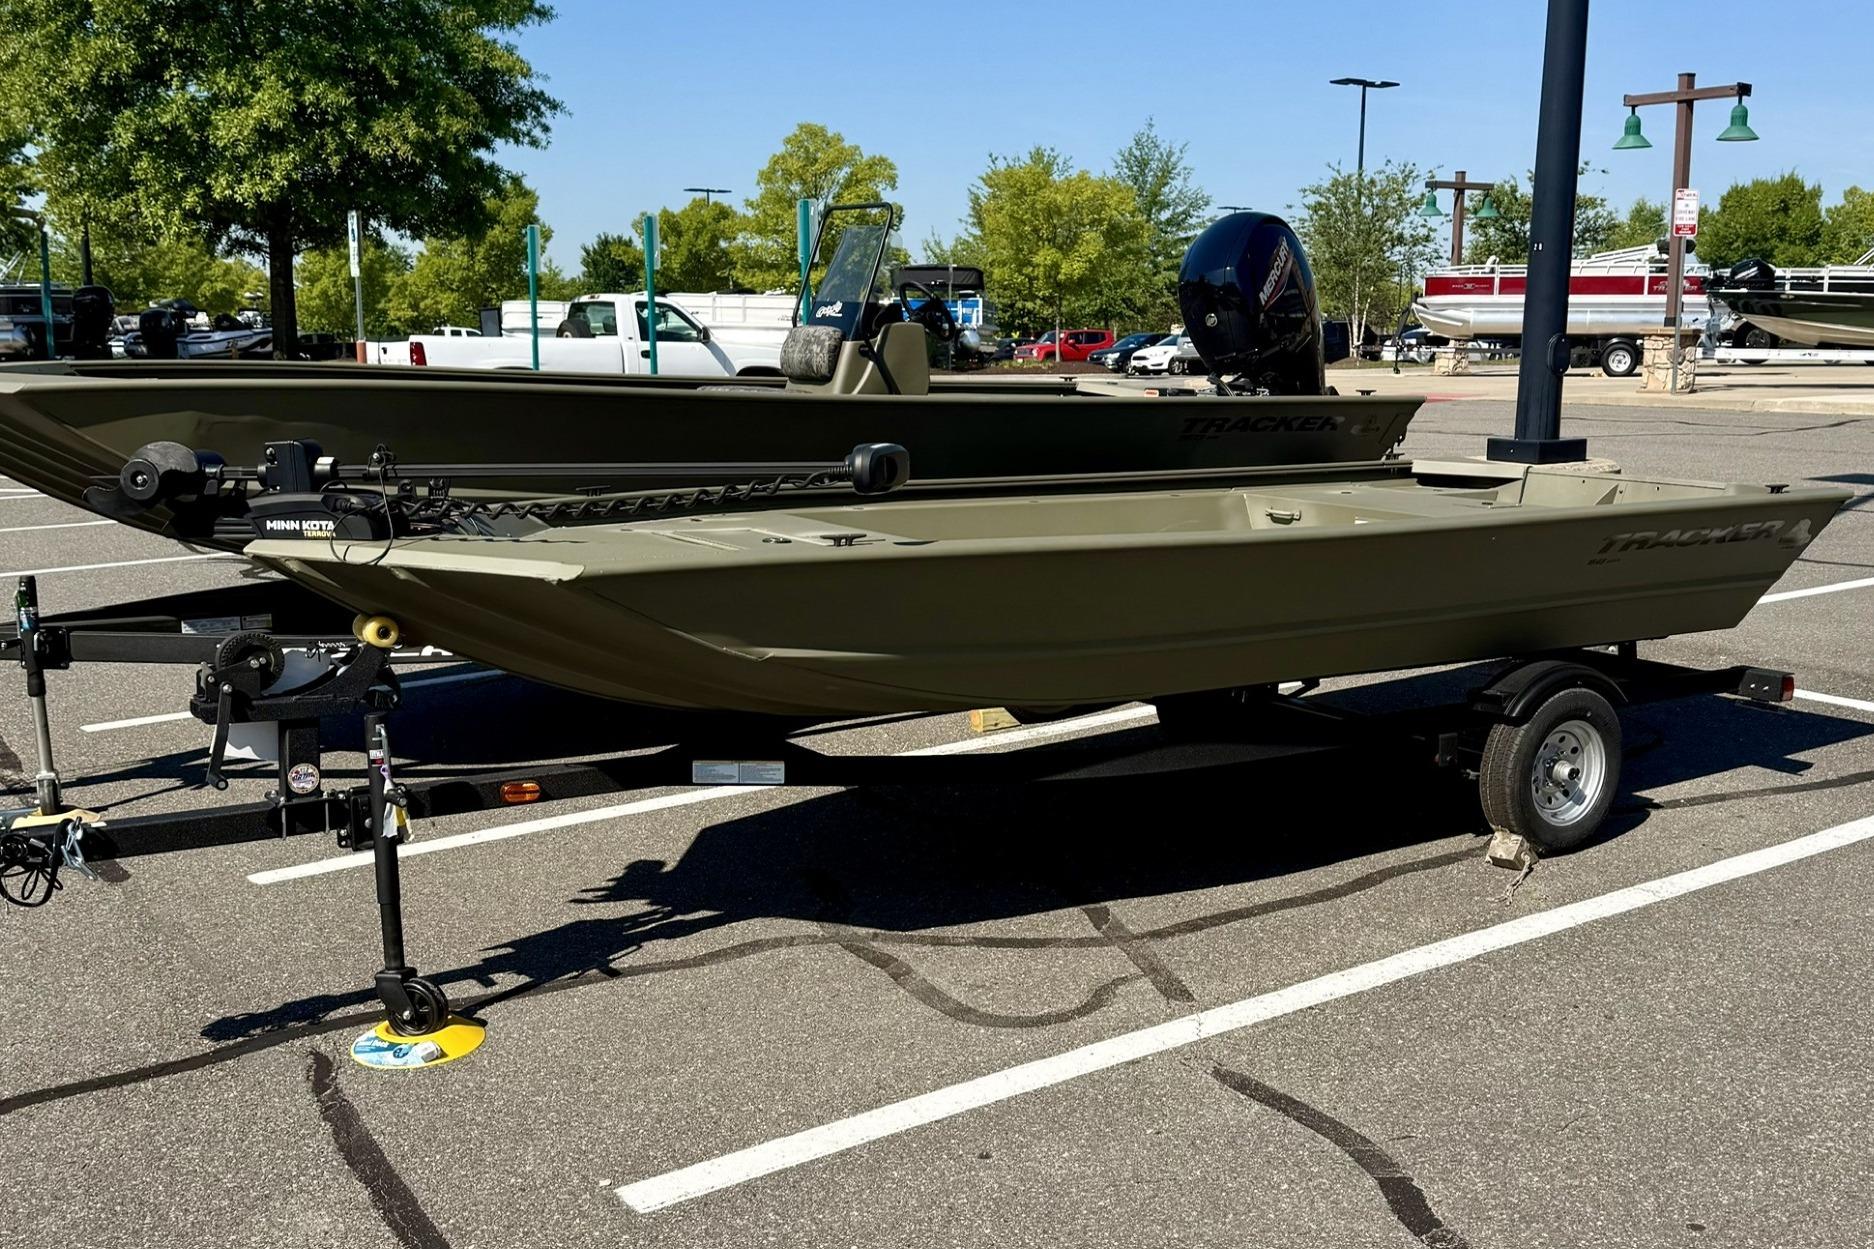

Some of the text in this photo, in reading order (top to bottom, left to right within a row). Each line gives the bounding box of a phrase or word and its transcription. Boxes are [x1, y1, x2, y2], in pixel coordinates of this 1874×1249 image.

[1259, 235, 1289, 306] MERCURY
[1183, 416, 1345, 433] TRACKER
[266, 520, 335, 531] MINN KOTA
[1597, 520, 1785, 554] TRACKER
